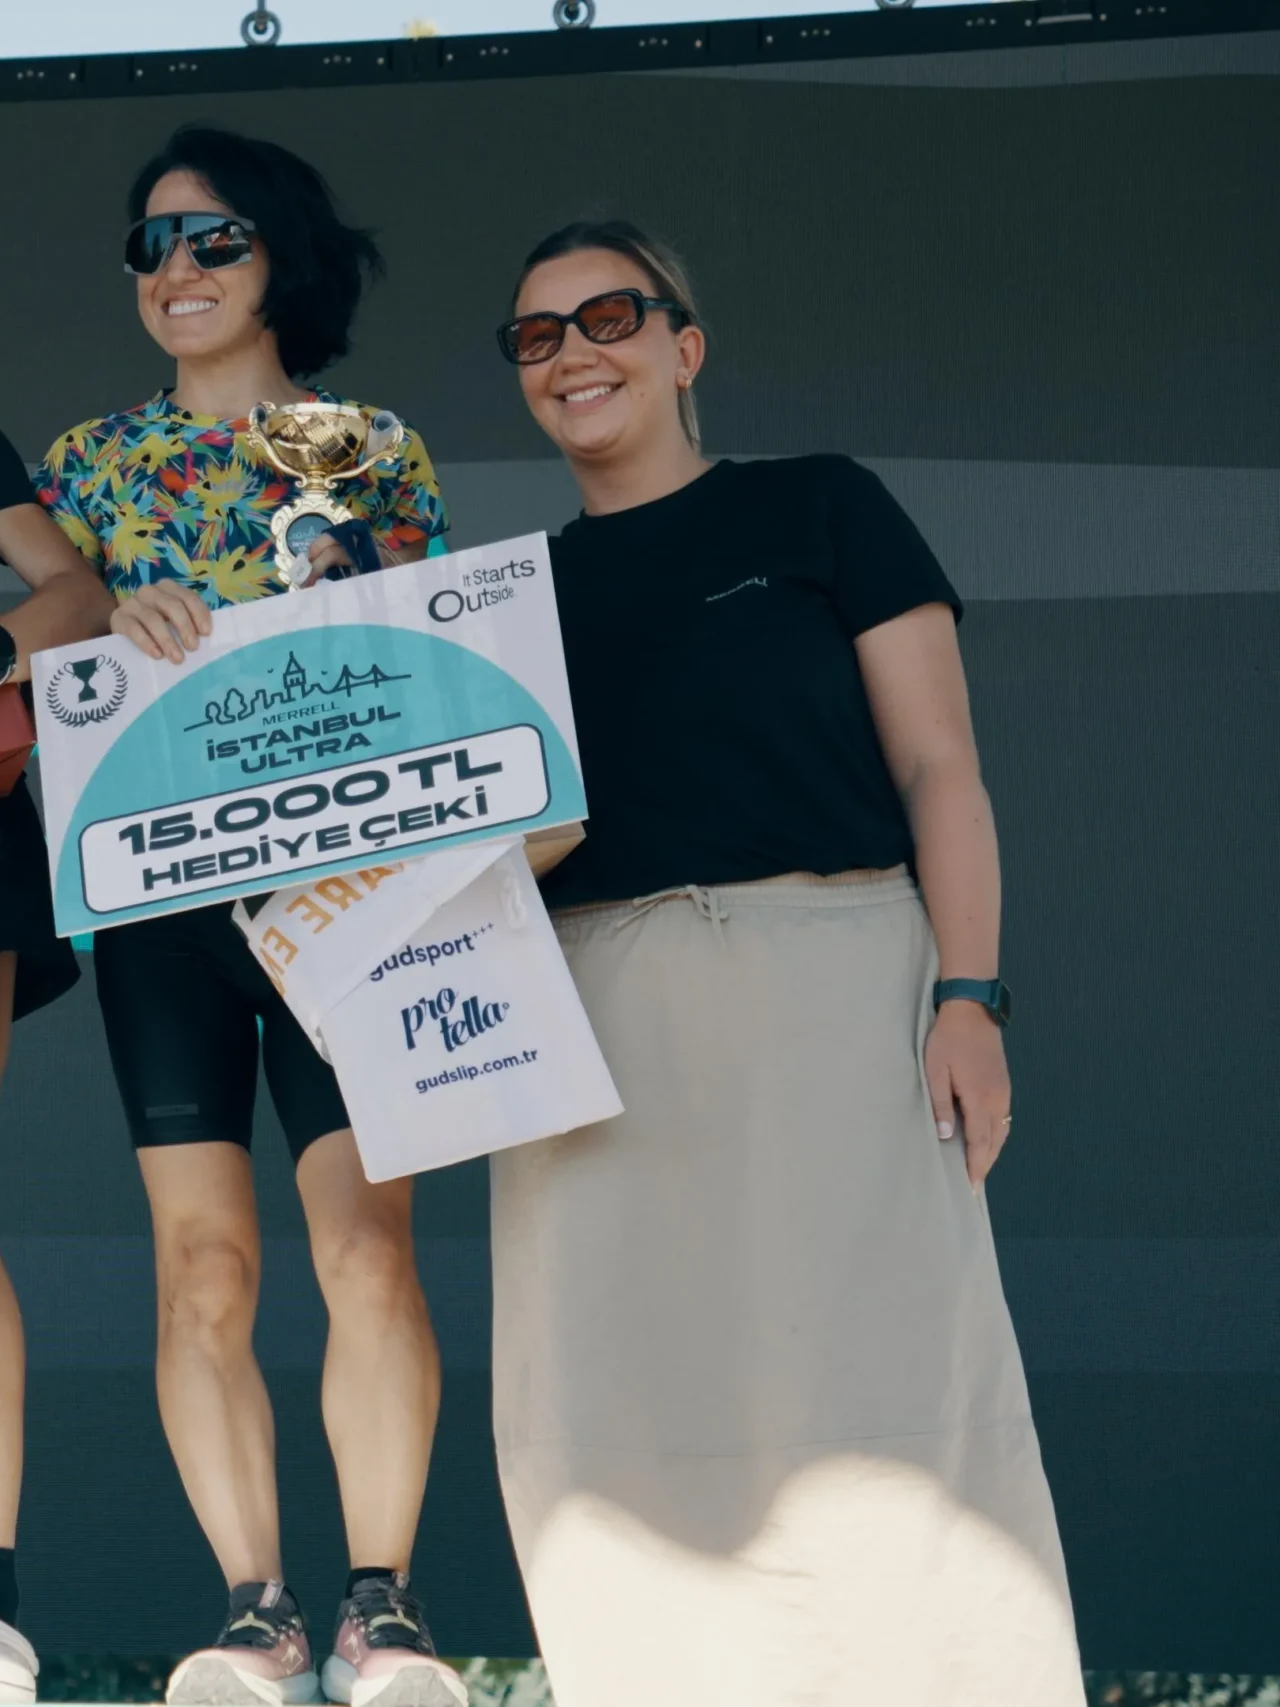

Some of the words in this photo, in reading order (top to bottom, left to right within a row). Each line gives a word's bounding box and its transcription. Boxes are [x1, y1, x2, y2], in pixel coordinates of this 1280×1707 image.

[473, 560, 536, 585] Starts
[428, 584, 514, 623] Outside
[206, 706, 401, 762] İSTANBUL
[262, 701, 340, 726] MERRELL
[240, 731, 372, 774] ULTRA
[118, 769, 390, 856] 15.000
[397, 748, 504, 792] TL
[143, 822, 352, 891] HEDİYE
[359, 785, 490, 848] ÇEKİ
[401, 987, 459, 1051] pro
[440, 995, 506, 1053] tella
[415, 1049, 538, 1094] gudslip.com.tr
